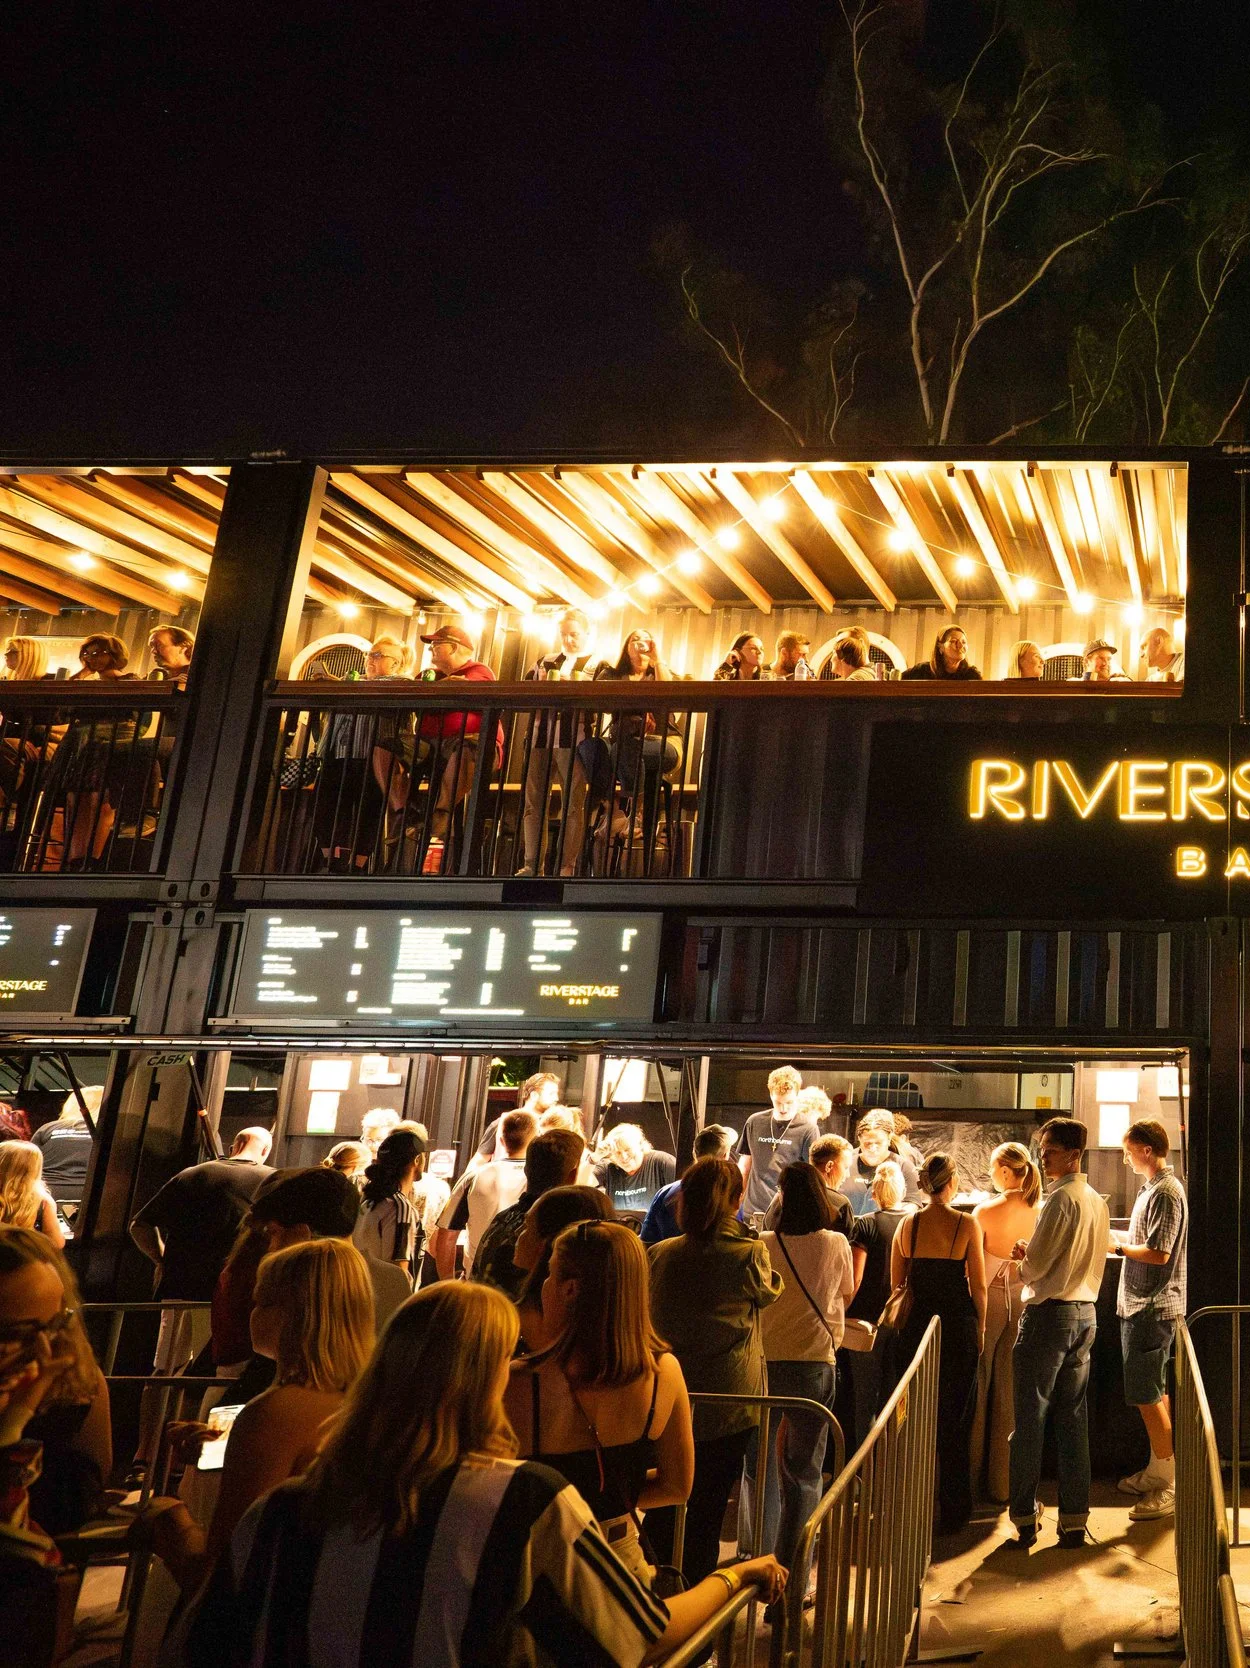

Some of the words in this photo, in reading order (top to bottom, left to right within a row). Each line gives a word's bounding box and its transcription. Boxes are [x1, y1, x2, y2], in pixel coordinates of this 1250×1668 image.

[540, 985, 620, 997] RIVERSTAGE
[568, 997, 589, 1005] BAR
[147, 1054, 186, 1066] CASH
